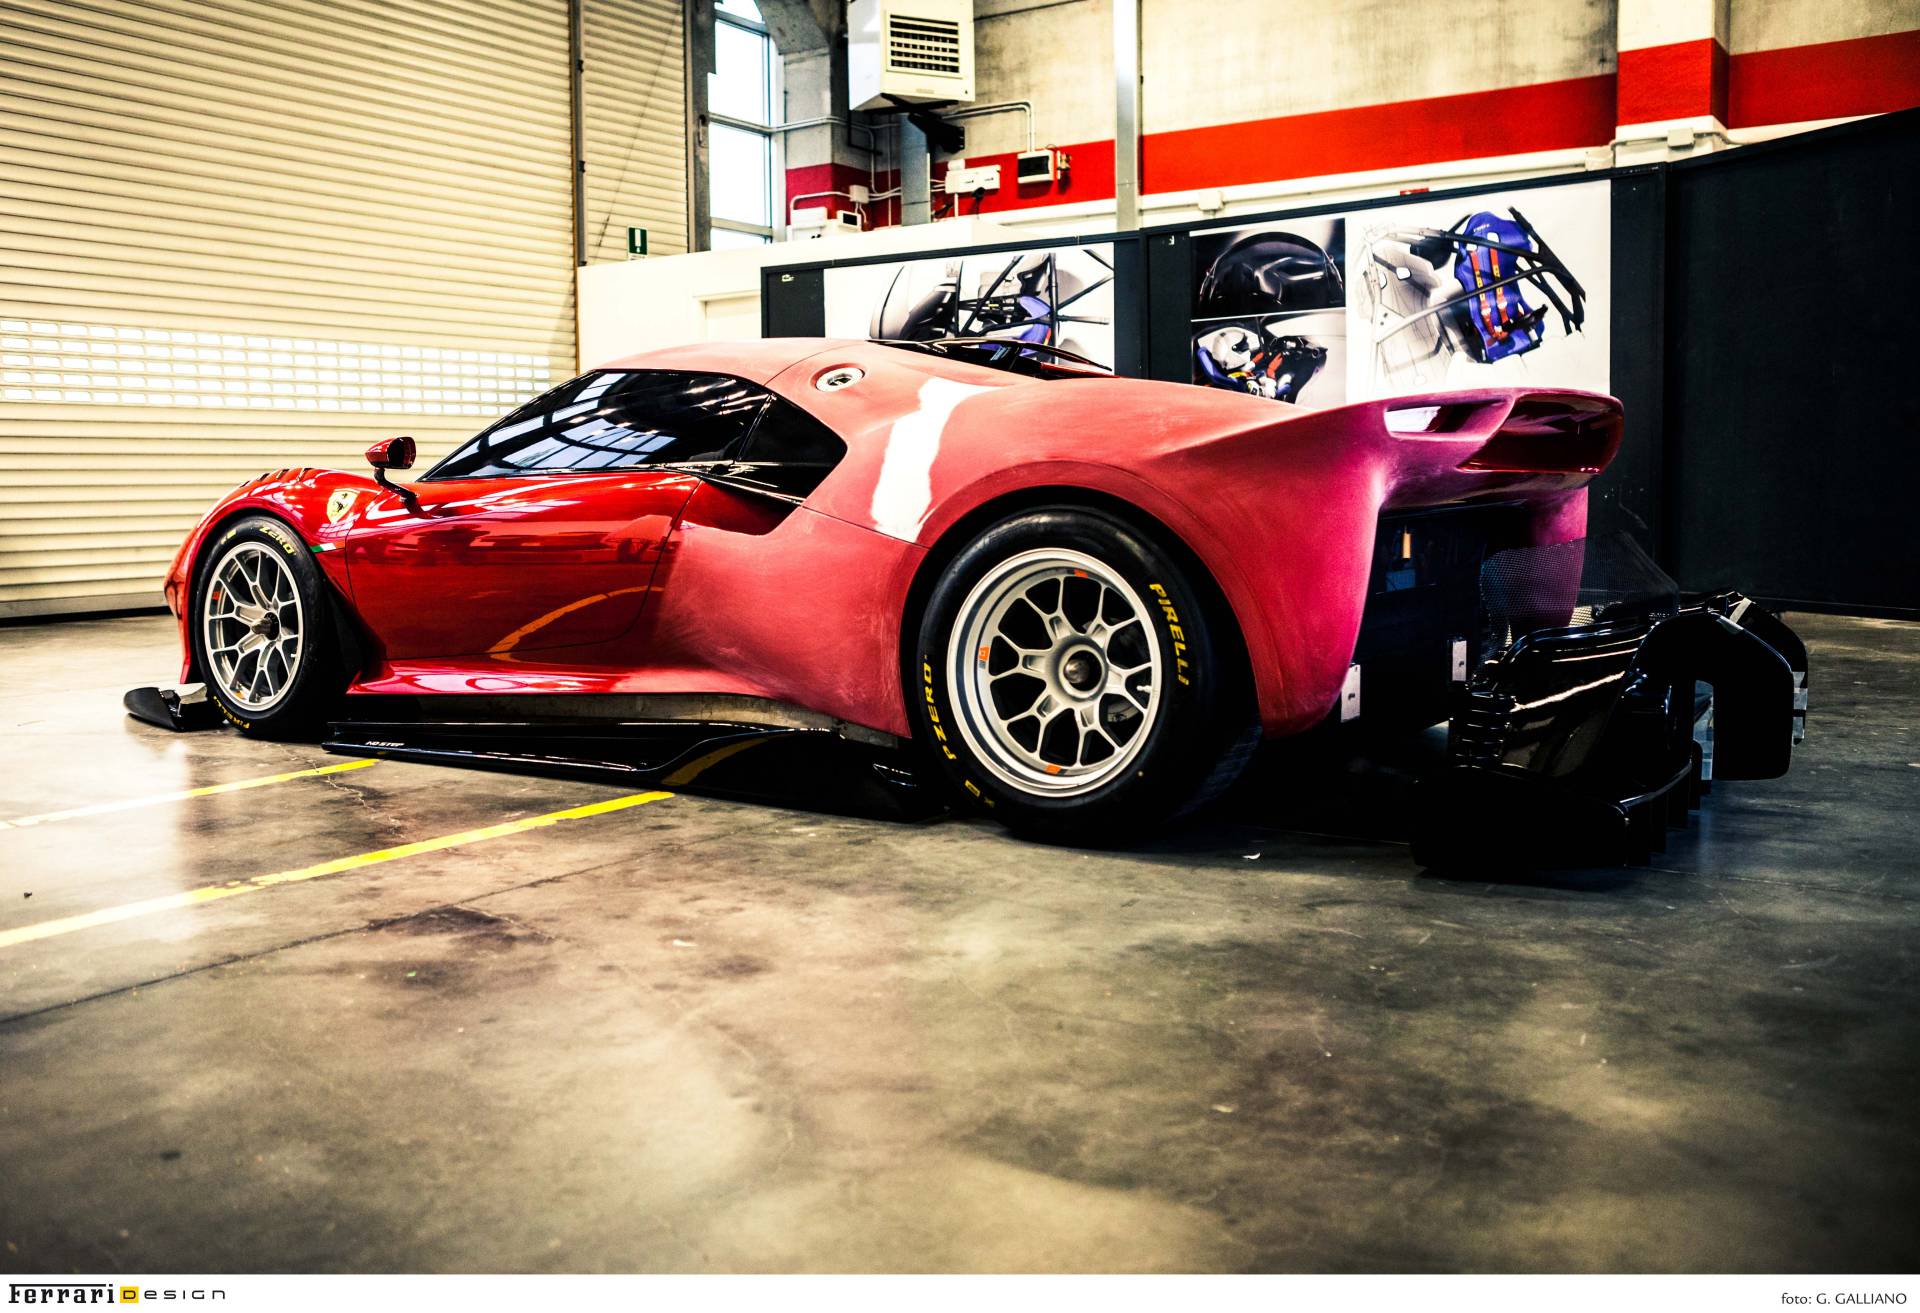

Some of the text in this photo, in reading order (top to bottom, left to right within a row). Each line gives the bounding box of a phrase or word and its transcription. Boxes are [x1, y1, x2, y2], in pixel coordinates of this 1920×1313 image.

[1149, 583, 1189, 686] PIRELLI
[924, 662, 957, 760] P ZERO
